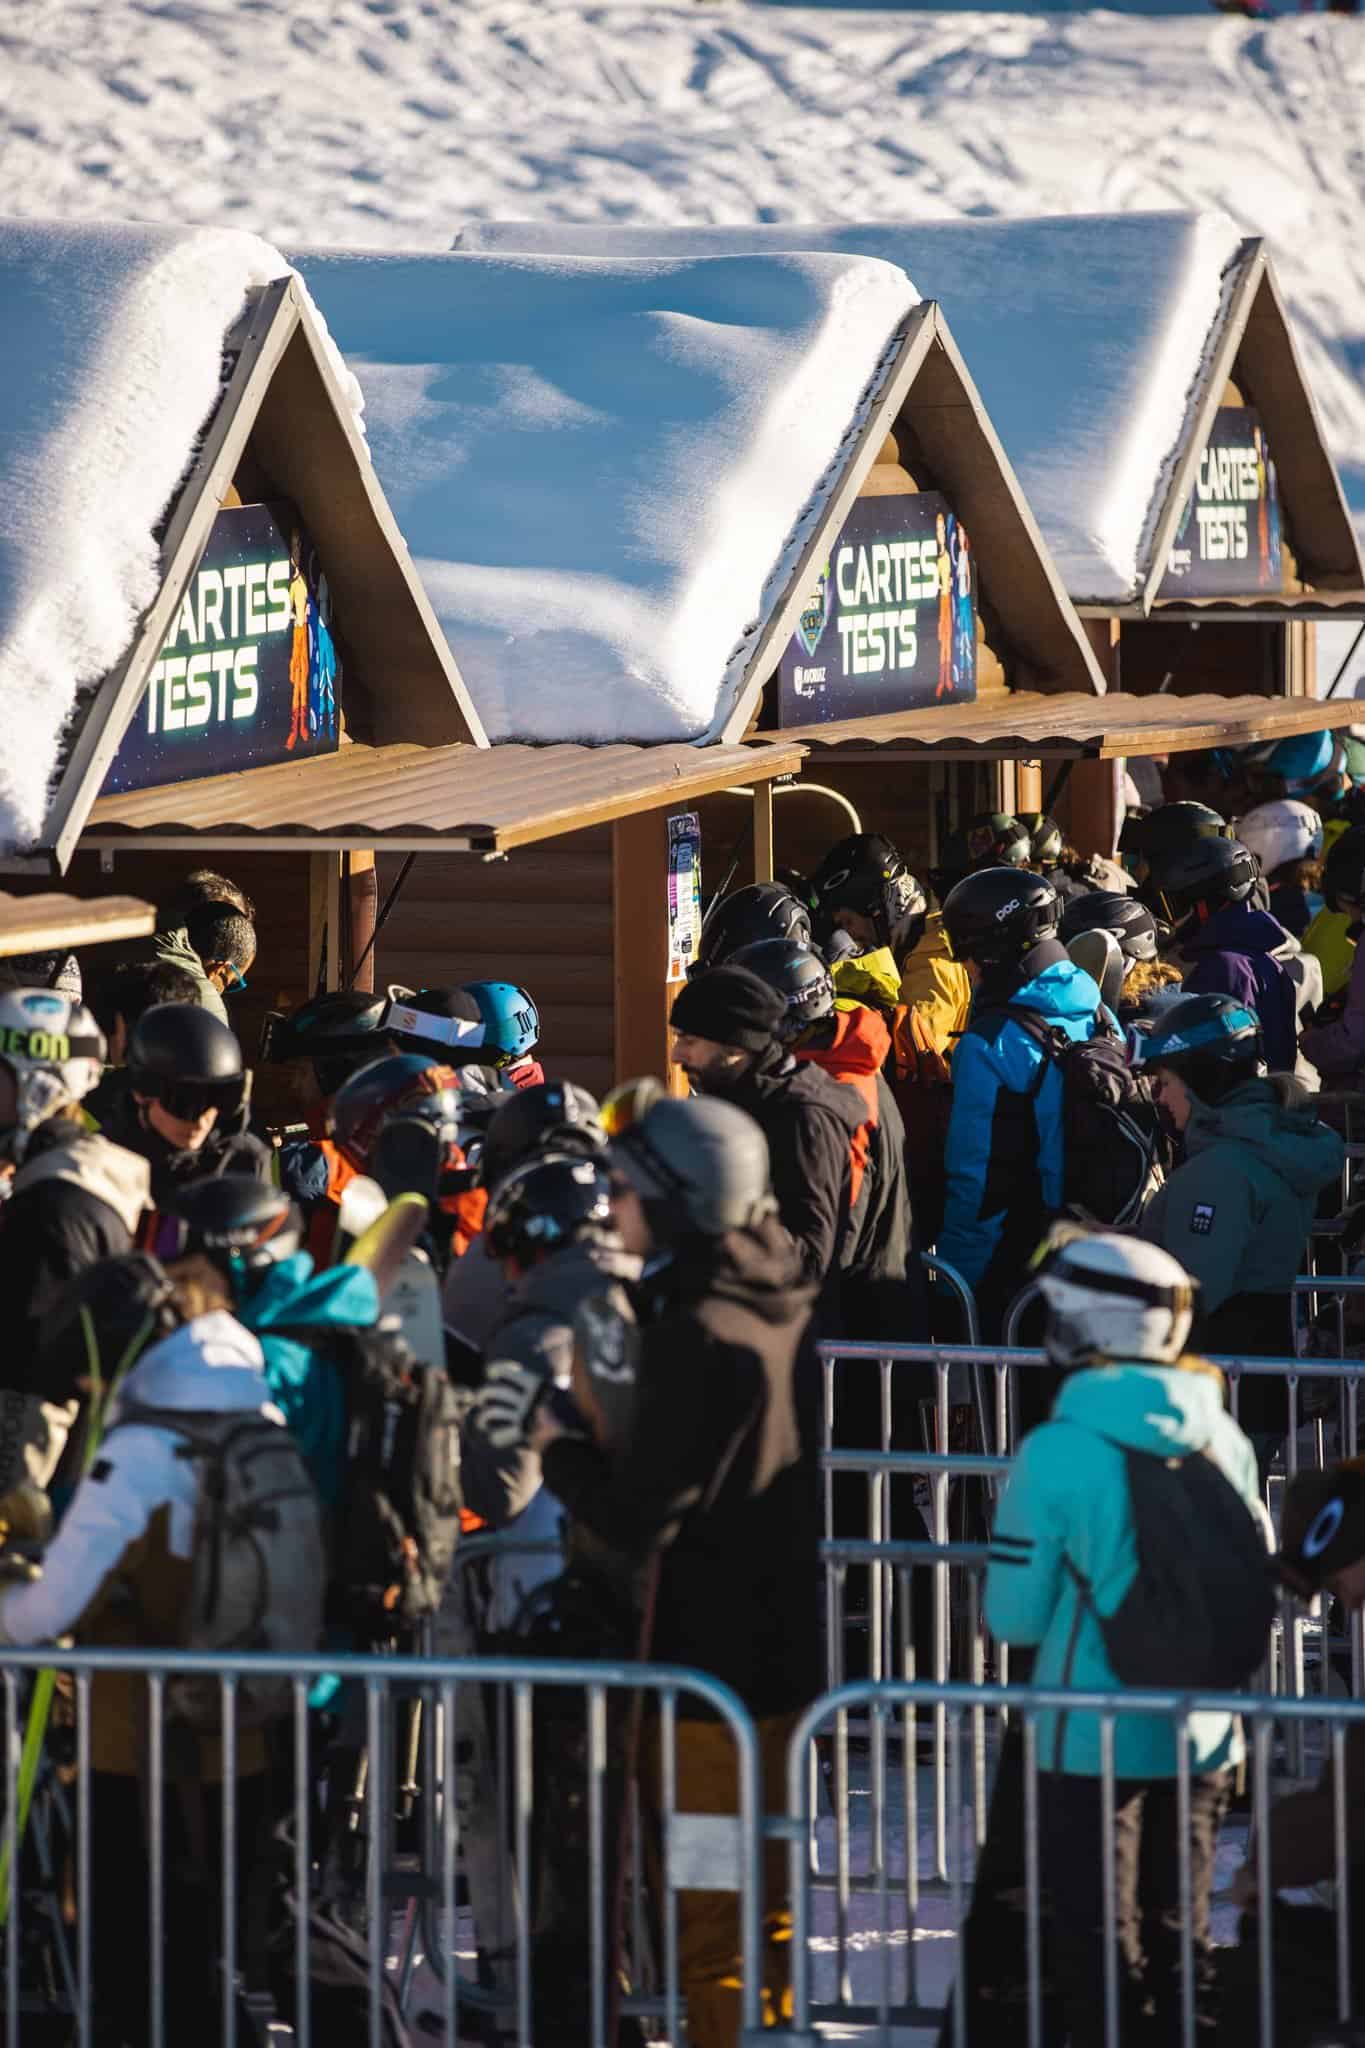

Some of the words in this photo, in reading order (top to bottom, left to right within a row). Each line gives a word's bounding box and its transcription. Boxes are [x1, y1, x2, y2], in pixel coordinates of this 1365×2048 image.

[1197, 448, 1259, 500] CARTES
[1197, 505, 1248, 560] TESTS
[163, 560, 290, 649] ARTES
[837, 539, 939, 607] CARTES
[837, 608, 918, 676] TESTS
[147, 646, 258, 734] TESTS
